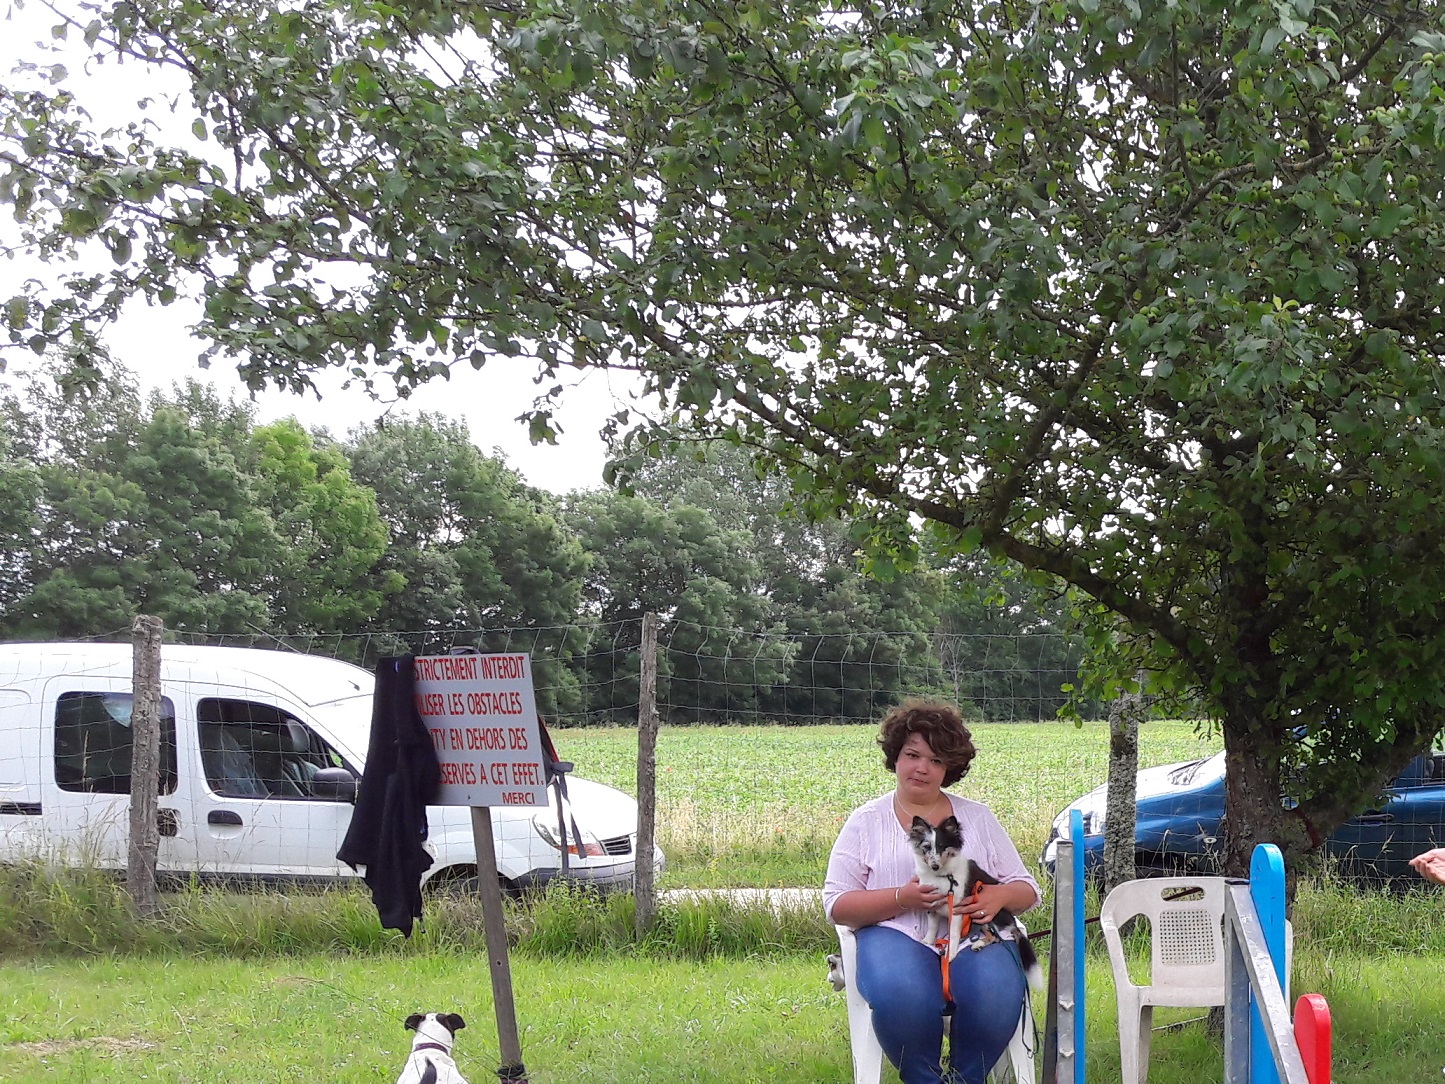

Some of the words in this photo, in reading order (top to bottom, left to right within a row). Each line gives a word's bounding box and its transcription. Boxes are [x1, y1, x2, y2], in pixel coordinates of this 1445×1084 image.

[480, 656, 525, 680] INTERDIT
[447, 693, 465, 716] LES
[467, 692, 523, 715] OBSTACLES
[450, 728, 464, 751] EN
[466, 728, 506, 750] DEHORS
[508, 727, 528, 750] DES
[438, 763, 477, 785] SERVES
[480, 763, 488, 785] A
[490, 763, 509, 785] CET
[512, 763, 544, 785] EFFET.
[502, 792, 536, 805] MERCI
